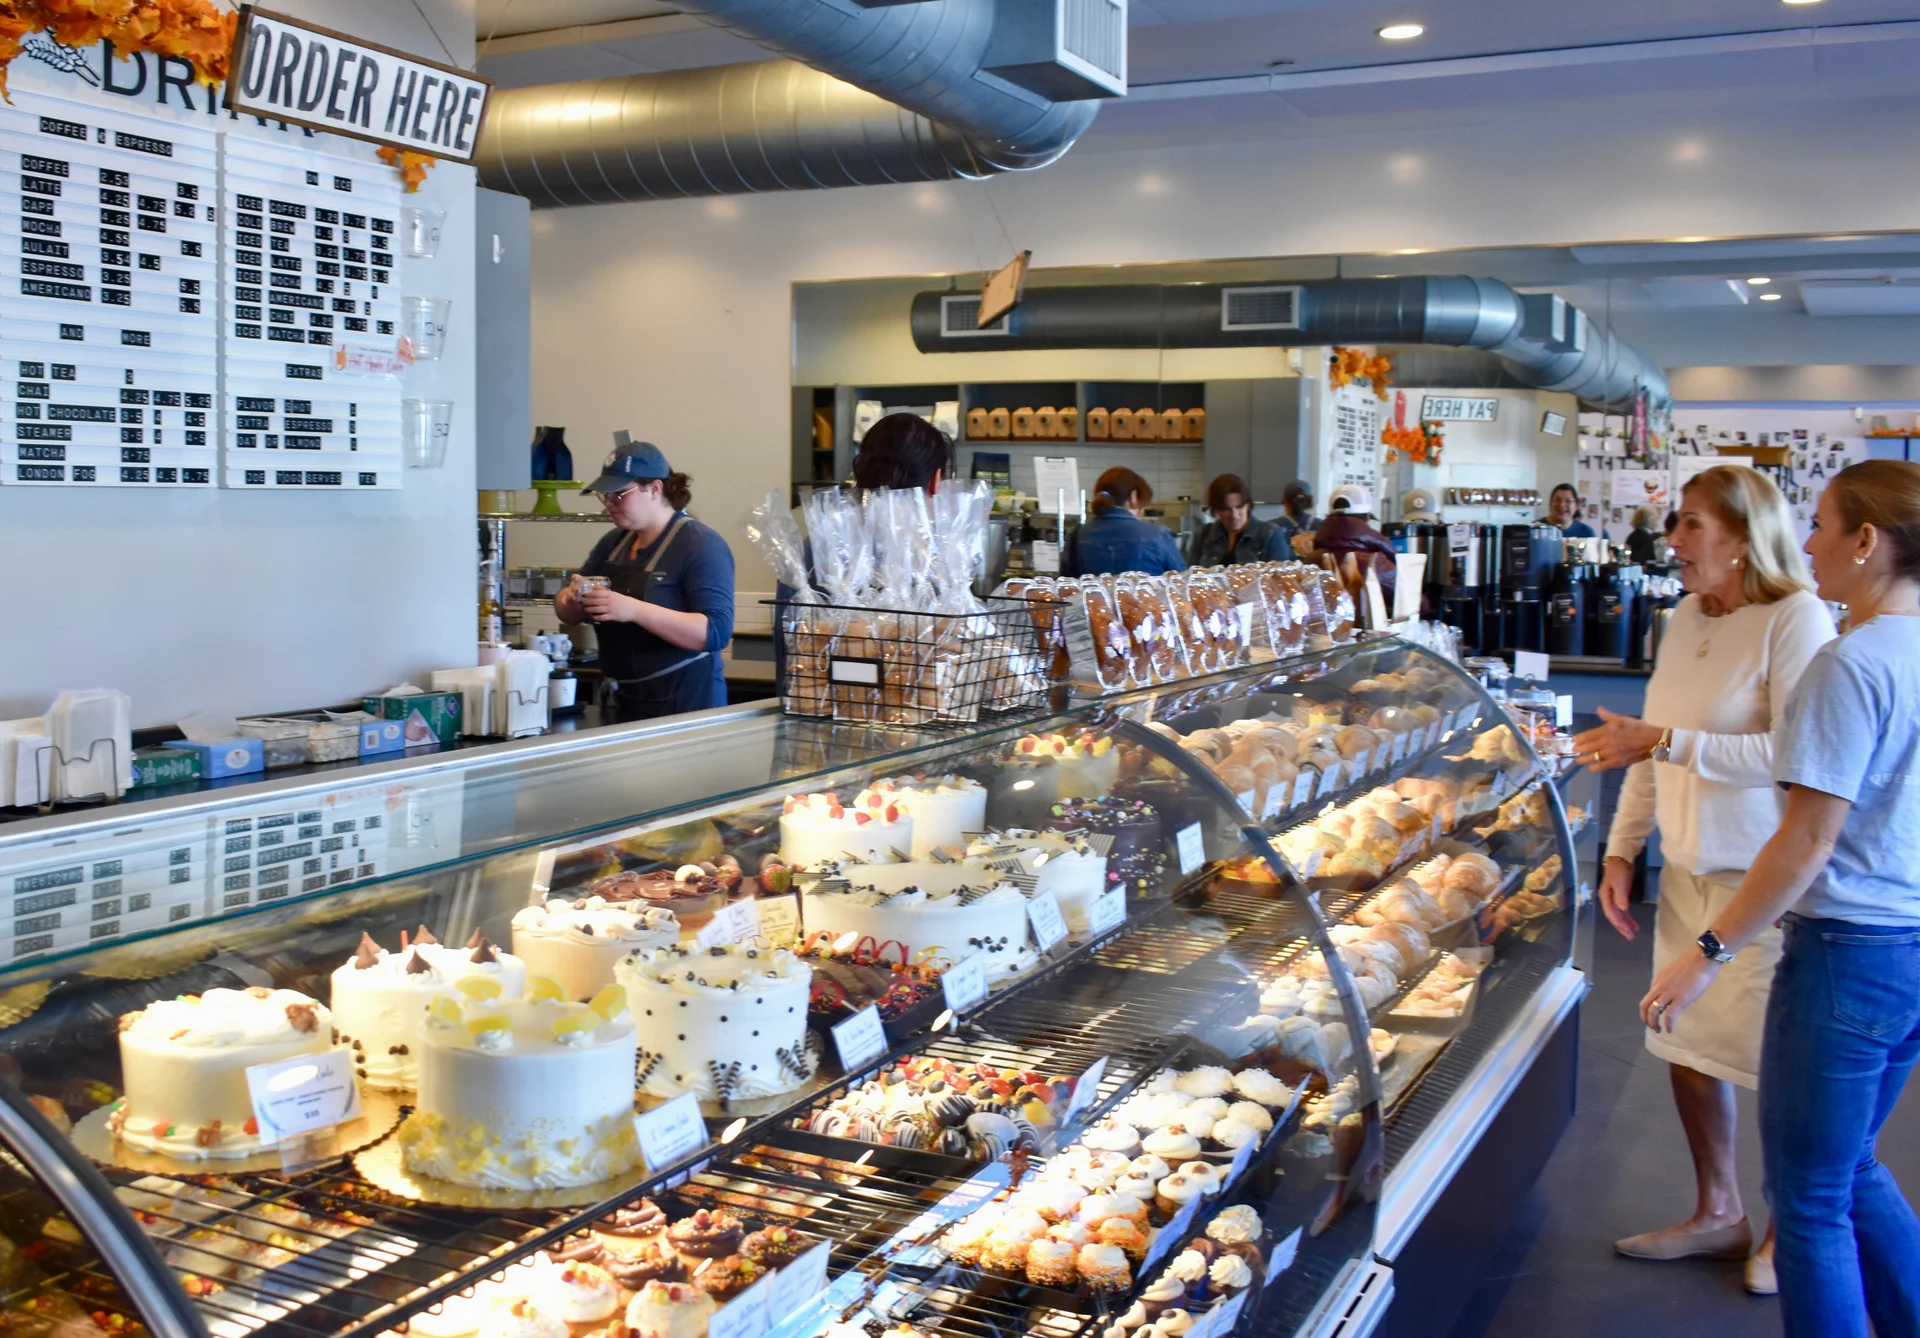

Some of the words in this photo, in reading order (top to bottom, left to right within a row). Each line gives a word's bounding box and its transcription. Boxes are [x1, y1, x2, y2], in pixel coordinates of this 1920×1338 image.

[243, 23, 379, 129] ORDER
[384, 66, 481, 152] HERE
[40, 119, 86, 139] COFFEE
[116, 134, 172, 156] ESPRESSO
[22, 157, 68, 176] COFFEE
[100, 171, 128, 186] 2.53
[178, 185, 197, 198] 3.5
[335, 179, 351, 190] ICE
[22, 178, 60, 195] LATTE
[100, 191, 129, 206] 4.25
[138, 198, 165, 212] 4.75
[22, 198, 53, 214] CAPP
[101, 211, 129, 226] 4.25
[138, 217, 165, 231] 4.75
[238, 197, 262, 210] ICED
[270, 203, 306, 218] COFFEE
[316, 211, 338, 223] 3.25
[344, 216, 365, 228] 3.75
[372, 221, 392, 232] 4.25
[22, 219, 60, 236] MOCHA
[100, 231, 128, 245] 4.55
[182, 243, 200, 256] 5.5
[238, 216, 262, 228] COLD
[271, 221, 294, 233] BREW
[316, 228, 332, 239] 4.5
[372, 238, 387, 248] 5.5
[22, 240, 68, 257] AULAIT
[102, 251, 130, 265] 3.54
[140, 256, 160, 269] 4.5
[237, 234, 262, 246] ICED
[271, 239, 288, 250] TEA
[316, 246, 338, 258] 3.25
[344, 250, 365, 262] 3.75
[372, 255, 392, 266] 4.25
[22, 260, 83, 279] ESPRESSO
[102, 271, 130, 285] 3.25
[180, 281, 199, 293] 5.5
[236, 252, 261, 265] ICED
[272, 257, 301, 270] LATTE
[317, 264, 339, 275] 4.25
[345, 268, 367, 279] 4.75
[373, 272, 388, 282] 5.5
[237, 271, 261, 283] ICED
[271, 275, 300, 288] MOCHA
[317, 281, 333, 292] 4.5
[22, 281, 90, 300] AMERICANO
[102, 291, 130, 304] 3.25
[181, 300, 200, 312] 5.5
[236, 289, 261, 301] ICED
[270, 293, 323, 308] AMERICANO
[333, 301, 355, 312] 3.25
[236, 308, 261, 319] ICED
[270, 312, 294, 322] CHAI
[311, 316, 332, 326] 4.25
[346, 320, 366, 330] 4.75
[378, 324, 392, 333] 5.5
[61, 326, 82, 339] AND
[122, 332, 150, 345] MORE
[236, 326, 260, 337] ICED
[269, 329, 304, 341] MATCHA
[309, 333, 332, 344] 4.75
[21, 364, 43, 377] HOT
[52, 366, 74, 379] TEA
[287, 367, 322, 378] EXTRAS
[18, 385, 49, 398] CHAI
[121, 391, 148, 403] 4.25
[154, 394, 180, 405] 4.75
[186, 396, 210, 406] 5.25
[238, 400, 274, 411] FLAVOR
[286, 402, 310, 413] SHOT
[17, 405, 40, 418] HOT
[49, 407, 115, 421] CHOCOLATE
[18, 426, 71, 439] STEAMER
[238, 418, 268, 428] EXTRA
[285, 420, 332, 431] ESPRESSO
[19, 447, 64, 459] MATCHA
[238, 436, 256, 446] OAT
[266, 437, 278, 447] OR
[286, 438, 320, 448] ALMOND
[18, 467, 64, 480] LONDON
[74, 469, 94, 480] FOG
[122, 470, 148, 481] 4.25
[157, 470, 176, 481] 4.5
[184, 471, 208, 482] 4.75
[246, 472, 264, 483] JOE
[306, 474, 340, 484] SERVES
[360, 475, 375, 484] TEN
